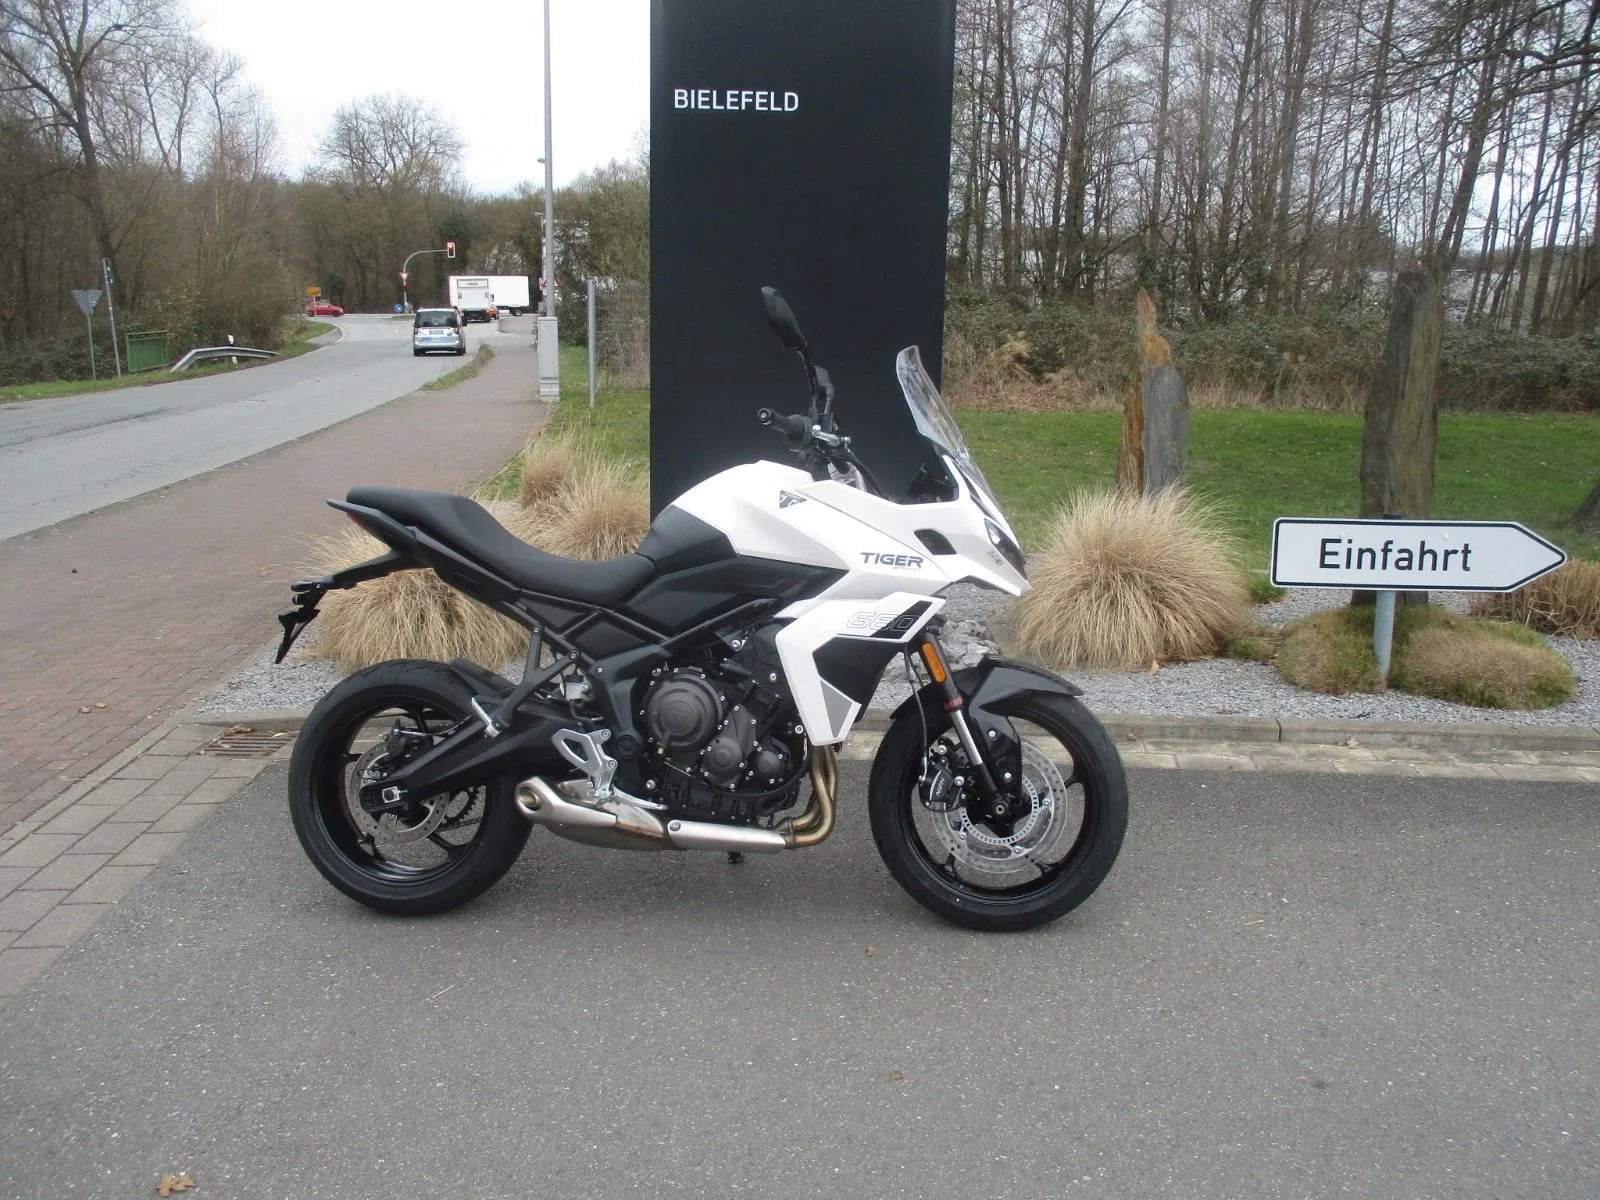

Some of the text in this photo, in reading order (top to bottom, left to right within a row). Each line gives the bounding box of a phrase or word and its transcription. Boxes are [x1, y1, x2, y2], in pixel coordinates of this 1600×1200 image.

[674, 89, 799, 111] BIELEFELD
[860, 552, 924, 568] TIGER
[1319, 538, 1472, 571] Einfahrt
[847, 612, 920, 631] 660
